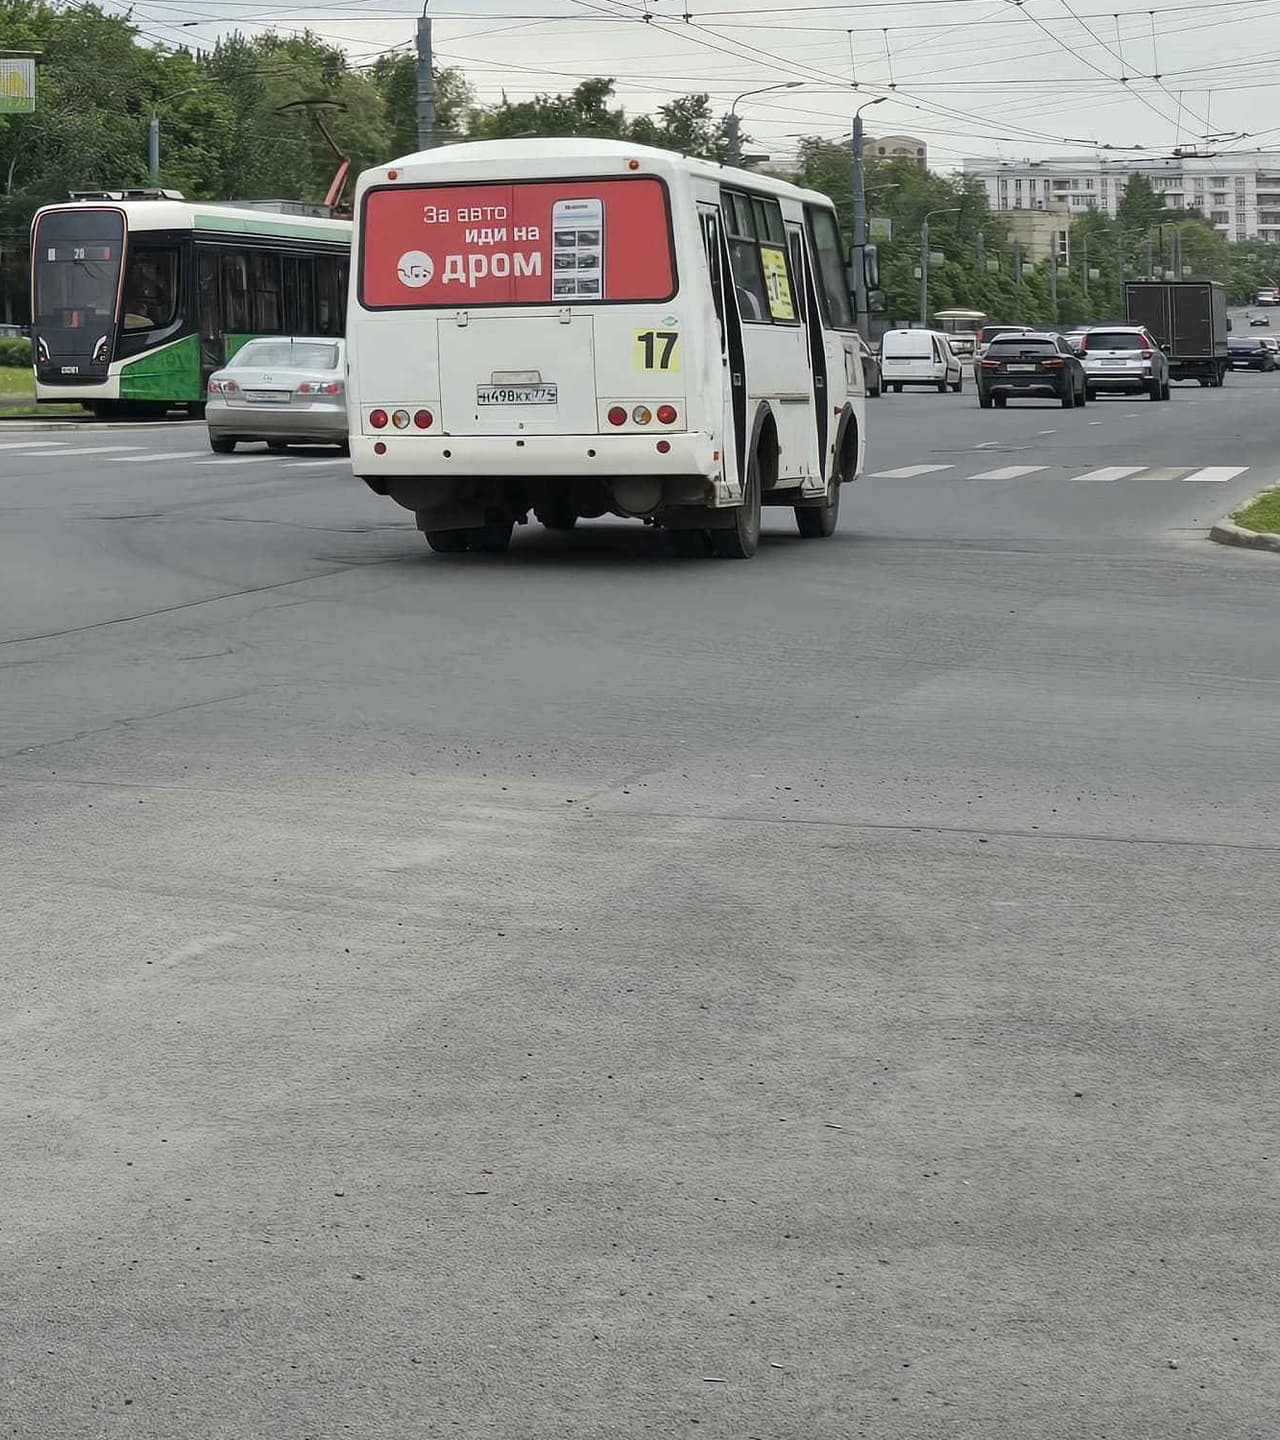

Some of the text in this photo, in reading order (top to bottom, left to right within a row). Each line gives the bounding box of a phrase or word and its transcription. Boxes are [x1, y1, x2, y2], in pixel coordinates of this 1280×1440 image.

[424, 206, 507, 223] За авто
[466, 226, 540, 246] иди на
[442, 251, 542, 288] дром
[638, 331, 679, 369] 17
